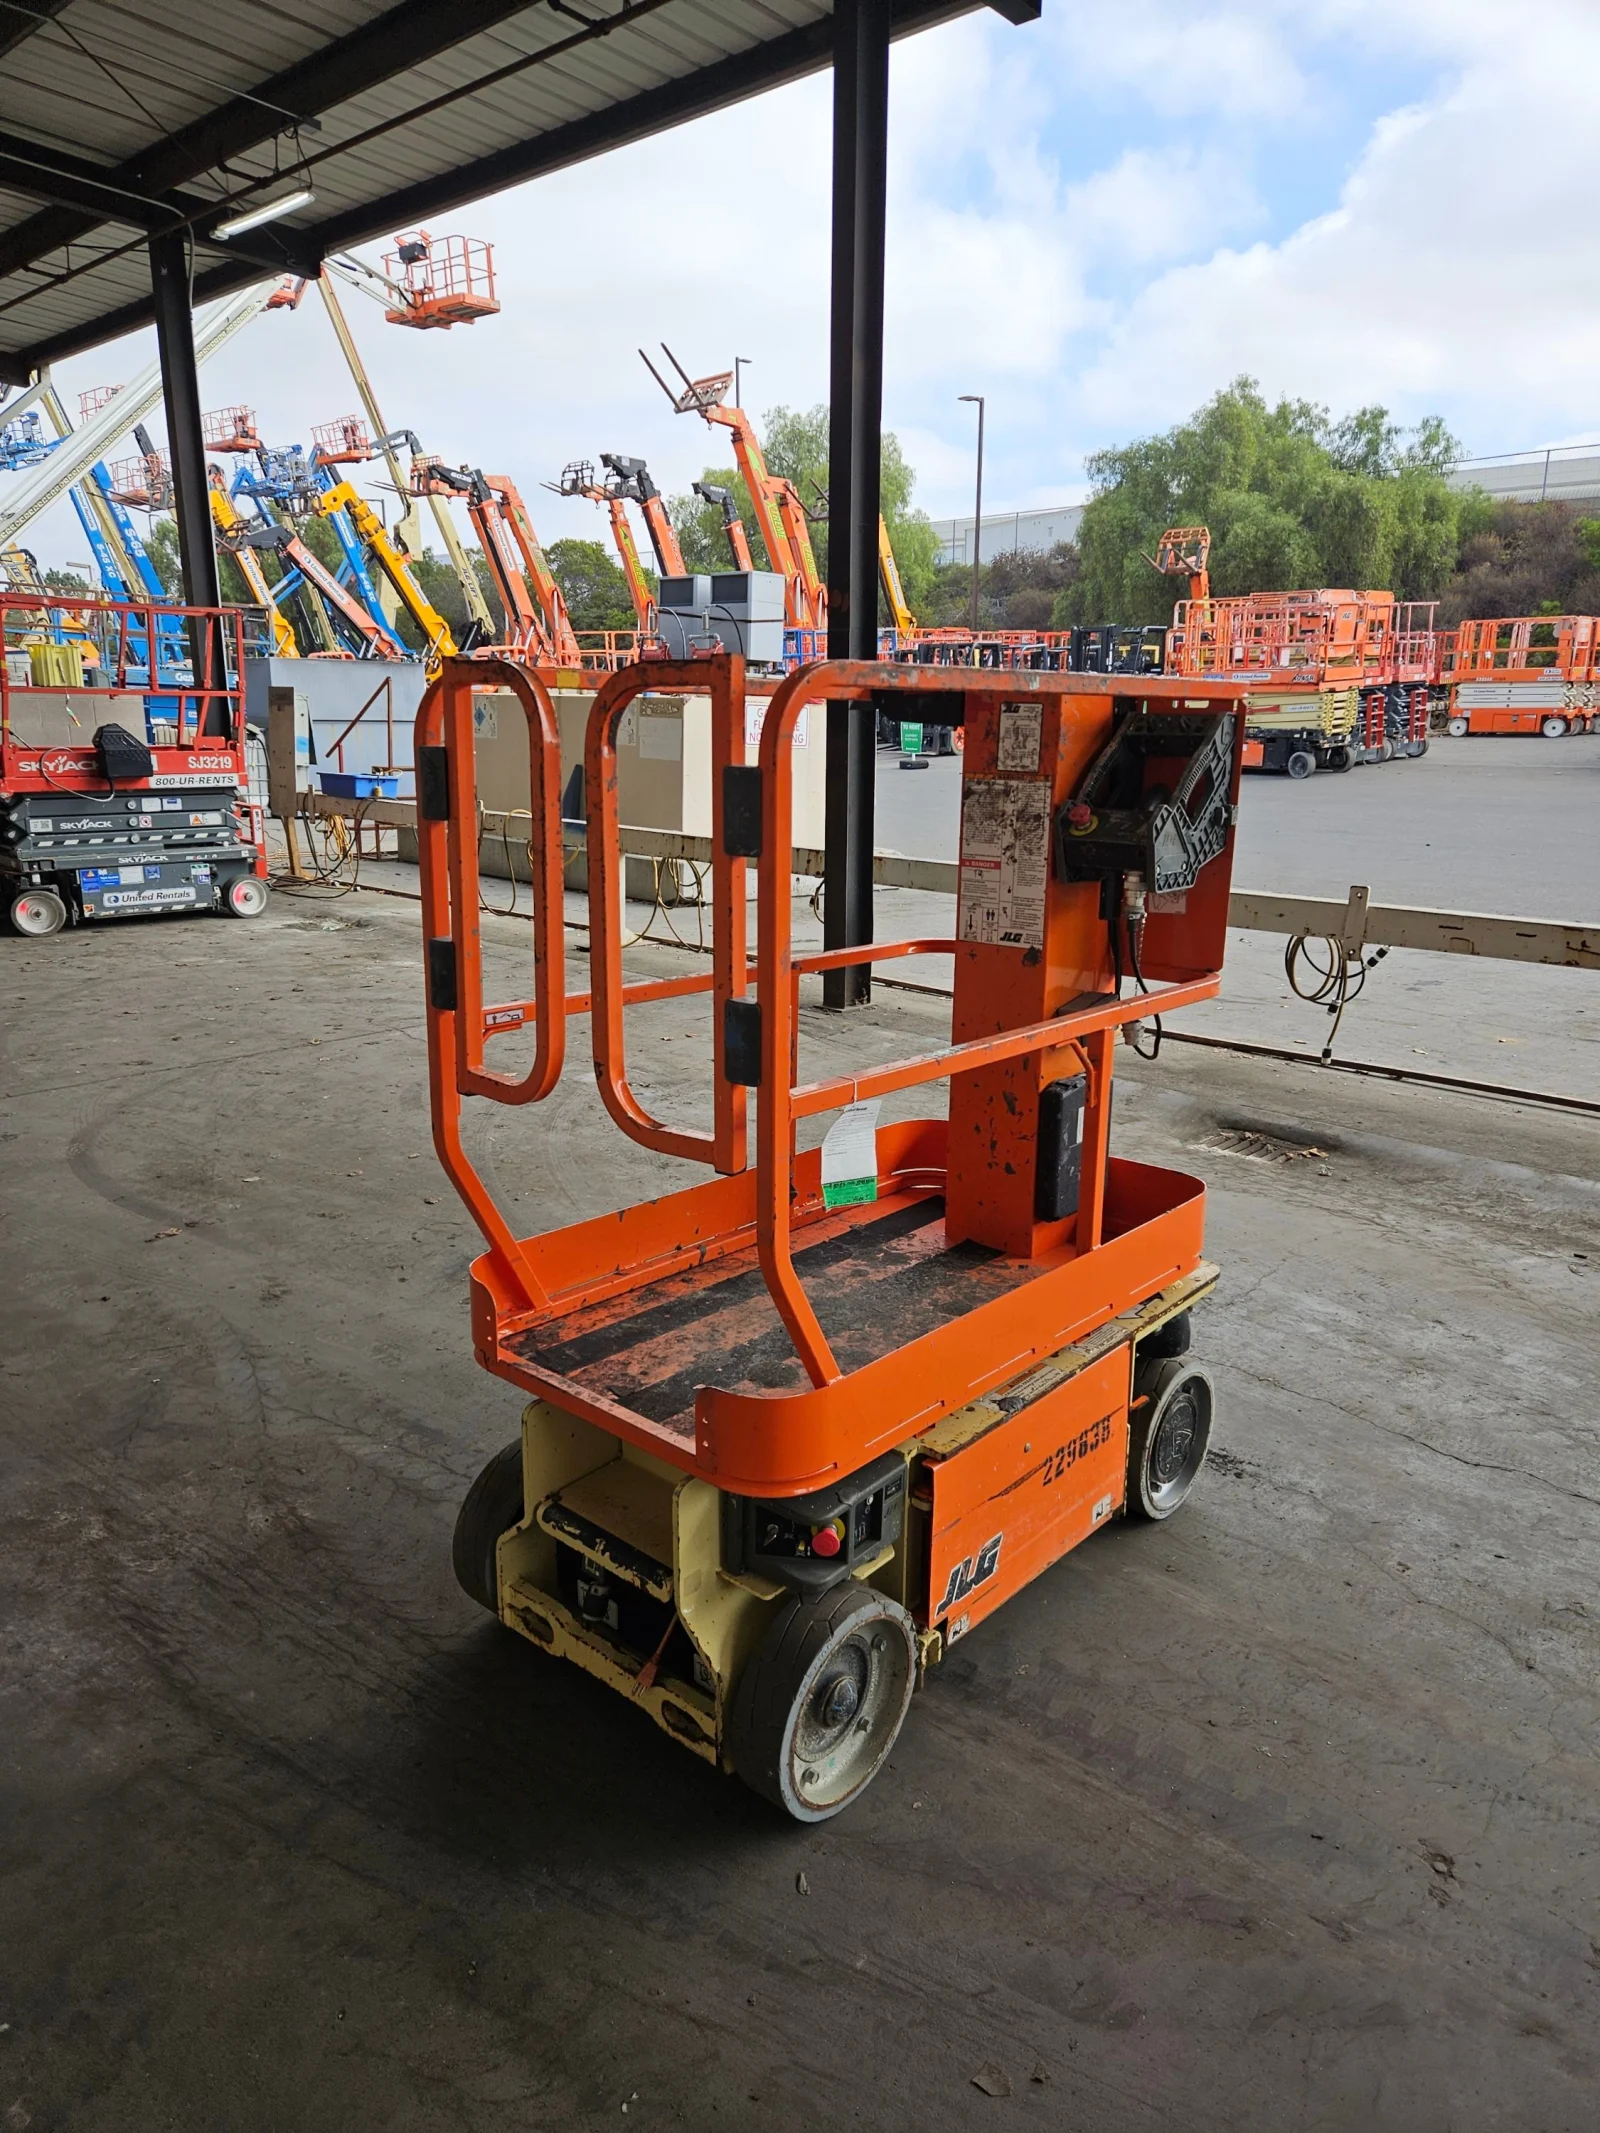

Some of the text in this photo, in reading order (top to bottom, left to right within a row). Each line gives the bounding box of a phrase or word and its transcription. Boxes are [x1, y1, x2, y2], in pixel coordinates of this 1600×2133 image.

[124, 527, 147, 558] S-65
[96, 543, 116, 579] S-45 XC
[247, 561, 261, 585] United
[310, 562, 346, 602] United Rentals
[174, 672, 195, 682] Gen
[1003, 703, 1021, 714] JLG
[187, 755, 232, 769] SJ3219
[155, 775, 234, 786] 800-UR-RENTS
[60, 818, 113, 830] SKYJACK
[118, 852, 169, 864] SKYJACK
[121, 889, 191, 904] United Rentals
[1000, 931, 1024, 943] JLG
[934, 1531, 1003, 1619] JLG
